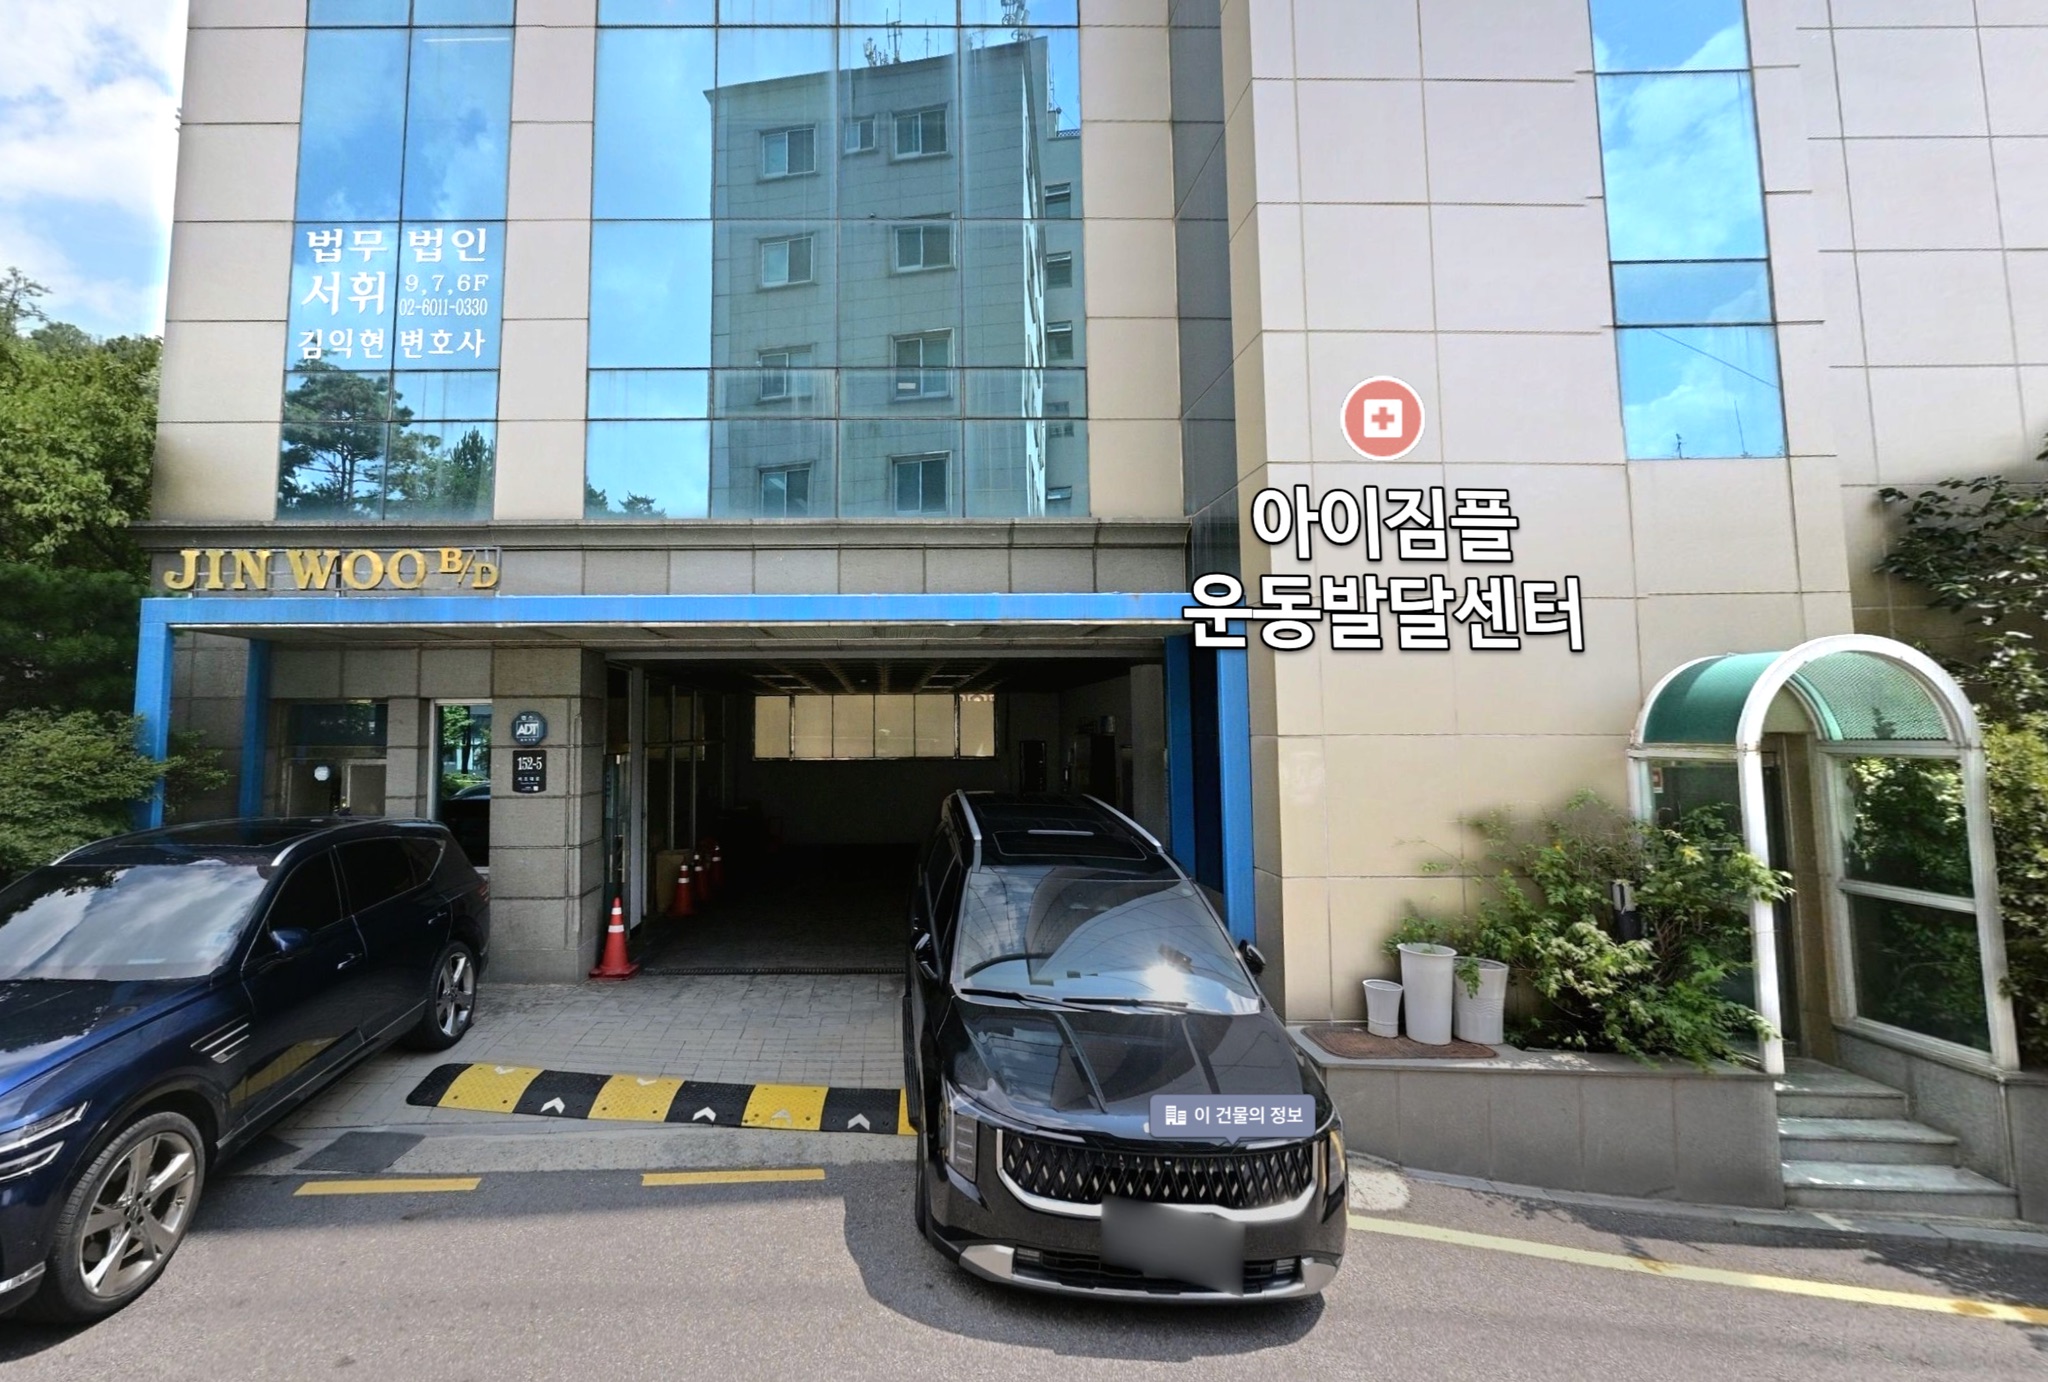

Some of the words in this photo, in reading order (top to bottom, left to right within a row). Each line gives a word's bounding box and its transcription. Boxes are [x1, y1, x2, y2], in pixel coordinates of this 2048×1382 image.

[306, 228, 389, 263] 법무
[407, 227, 487, 263] 법인
[301, 270, 386, 316] 서휘
[404, 273, 489, 297] 9,7,6F
[399, 298, 488, 316] 02-6011-0330
[297, 328, 386, 360] 김익현
[400, 328, 487, 360] 변호사
[163, 549, 271, 591] JIN
[286, 549, 428, 591] WOO
[438, 547, 499, 590] B/D
[516, 723, 539, 736] ADT
[517, 756, 543, 771] 152-5
